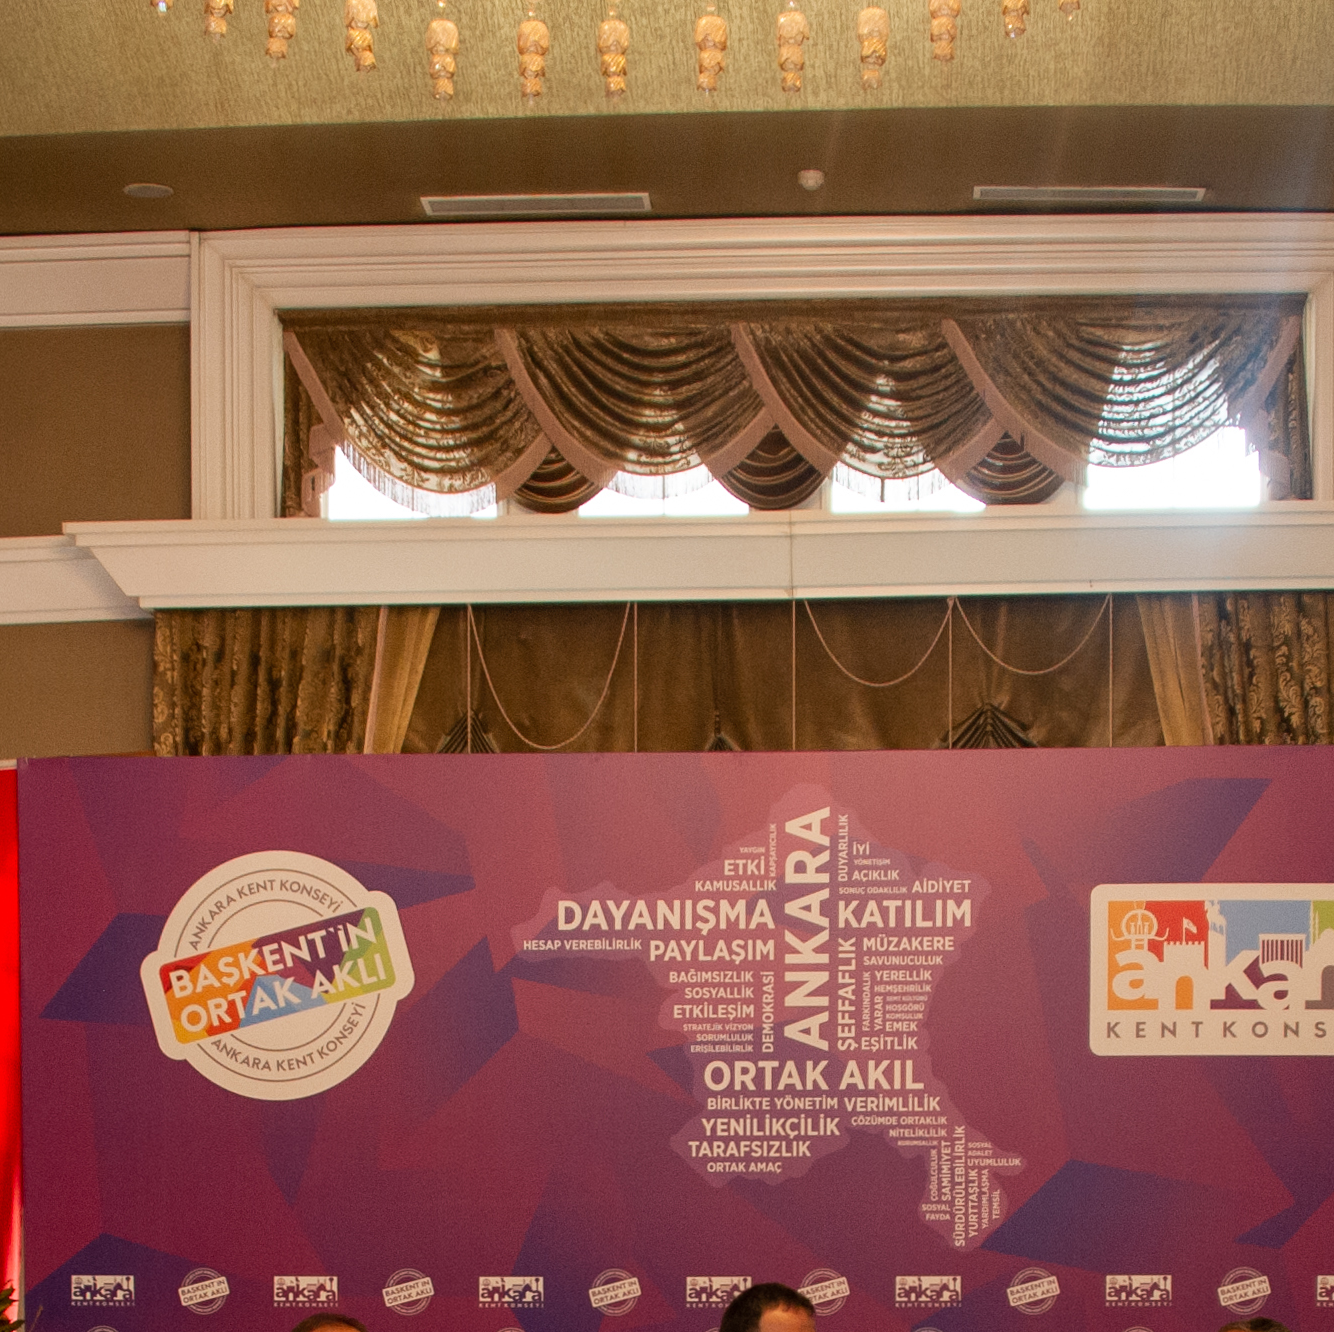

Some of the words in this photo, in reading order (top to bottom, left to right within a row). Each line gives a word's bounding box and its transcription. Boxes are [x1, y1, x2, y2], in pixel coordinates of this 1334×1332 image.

[838, 814, 848, 882] DUYARLILIK
[853, 842, 870, 855] İYİ
[724, 856, 765, 875] ETKİ
[852, 870, 899, 882] AÇIKLIK
[695, 880, 776, 891] KAMUSALLIK
[912, 878, 971, 893] AİDİYET
[189, 895, 236, 951] ANKARA
[236, 879, 276, 899] KENT
[279, 879, 344, 914] KONSEYİ
[558, 899, 775, 935] DAYANIŞMA
[839, 900, 971, 928] KATILIM
[784, 806, 830, 1051] ANKARA
[523, 939, 562, 950] HESAP
[564, 937, 642, 949] VEREBİLİRLİK
[863, 934, 954, 951] MÜZAKERE
[650, 939, 775, 965] PAYLAŞIM
[863, 955, 943, 965] SAVUNUCULUK
[669, 968, 754, 983] BAĞIMSIZLIK
[875, 968, 932, 981] YERELLİK
[181, 977, 302, 1033] ORTAK
[311, 953, 386, 998] AKLI
[685, 985, 754, 998] SOSYALLİK
[838, 937, 858, 1051] ŞEFFAFLIK
[874, 983, 932, 993] HEMŞEHRİLİK
[862, 971, 871, 1031] FARKINDALIK
[673, 1002, 754, 1020] ETKİLEŞİM
[760, 971, 774, 1053] DEMOKRASİ
[874, 995, 883, 1031] YARAR
[886, 1021, 918, 1031] EMEK
[1106, 1021, 1204, 1039] KENT
[211, 1038, 272, 1072] ANKARA
[276, 1052, 315, 1072] KENT
[317, 1002, 366, 1060] KONSEYİ
[861, 1034, 918, 1052] EŞİTLİK
[704, 1060, 829, 1091] ORTAK
[839, 1060, 924, 1090] AKIL
[707, 1095, 770, 1110] BİRLİKTE
[774, 1095, 838, 1110] YÖNETİM
[844, 1093, 941, 1112] VERİMLİLİK
[701, 1114, 840, 1139] YENİLİKÇİLİK
[851, 1115, 898, 1126] ÇÖZÜMDE
[900, 1116, 947, 1125] ORTAKLIK
[889, 1127, 947, 1137] NİTELİKLİLİK
[688, 1141, 811, 1157] TARAFSIZLIK
[707, 1162, 746, 1173] ORTAK
[748, 1162, 782, 1174] AMAÇ
[939, 1140, 951, 1201] SAMİMİYET
[967, 1158, 1021, 1167] UYUMLULUK
[952, 1125, 965, 1246] SÜRDÜRÜLEBİLİRLİK
[968, 1168, 980, 1238] YURTTAŞLIK
[991, 1189, 1000, 1219] TEMSİL
